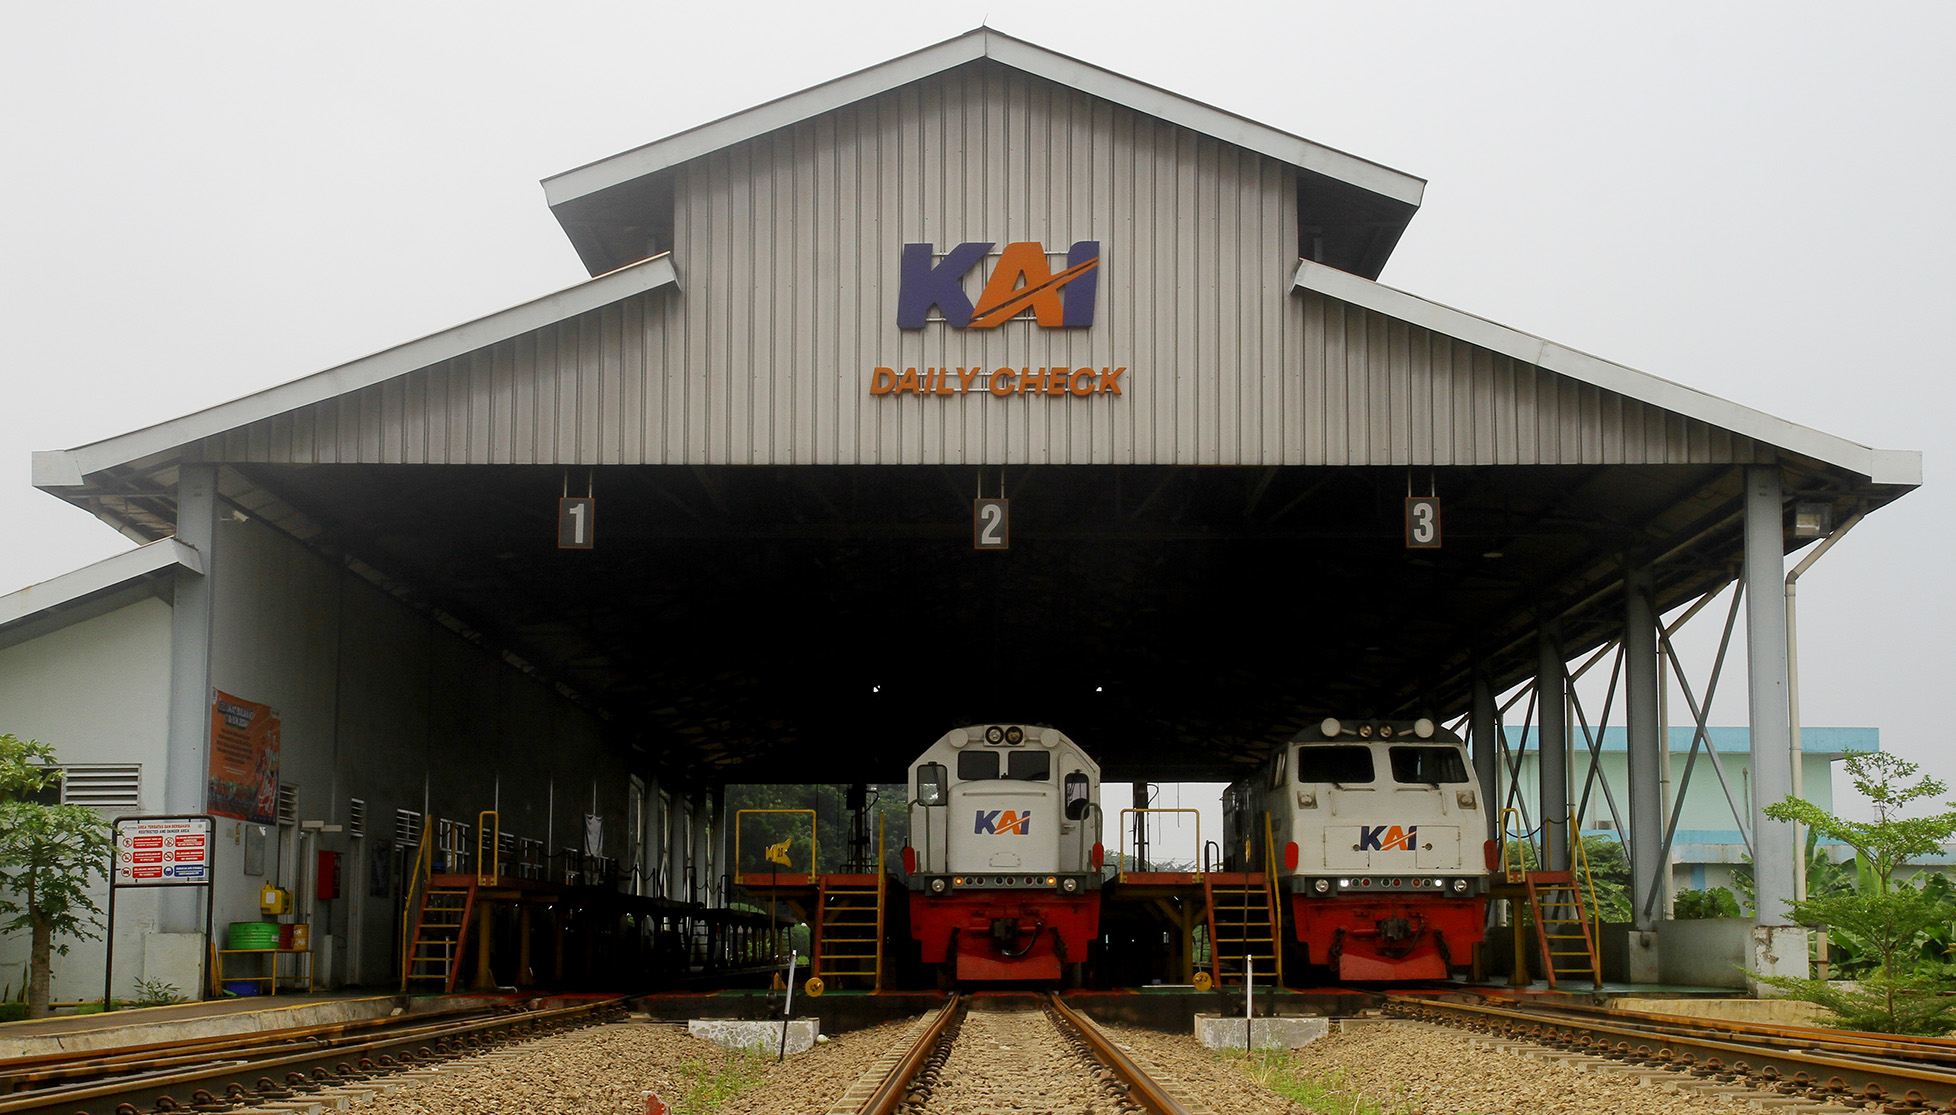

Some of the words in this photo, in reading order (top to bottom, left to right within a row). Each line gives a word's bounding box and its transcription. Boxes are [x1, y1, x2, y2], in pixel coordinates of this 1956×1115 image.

[896, 240, 1100, 328] KAI
[869, 366, 981, 396] DAILY
[988, 366, 1127, 397] CHECK
[569, 503, 585, 544] 1
[981, 503, 1002, 545] 2
[1413, 502, 1434, 543] 3
[974, 810, 1031, 836] KAI
[1360, 825, 1418, 851] KAI
